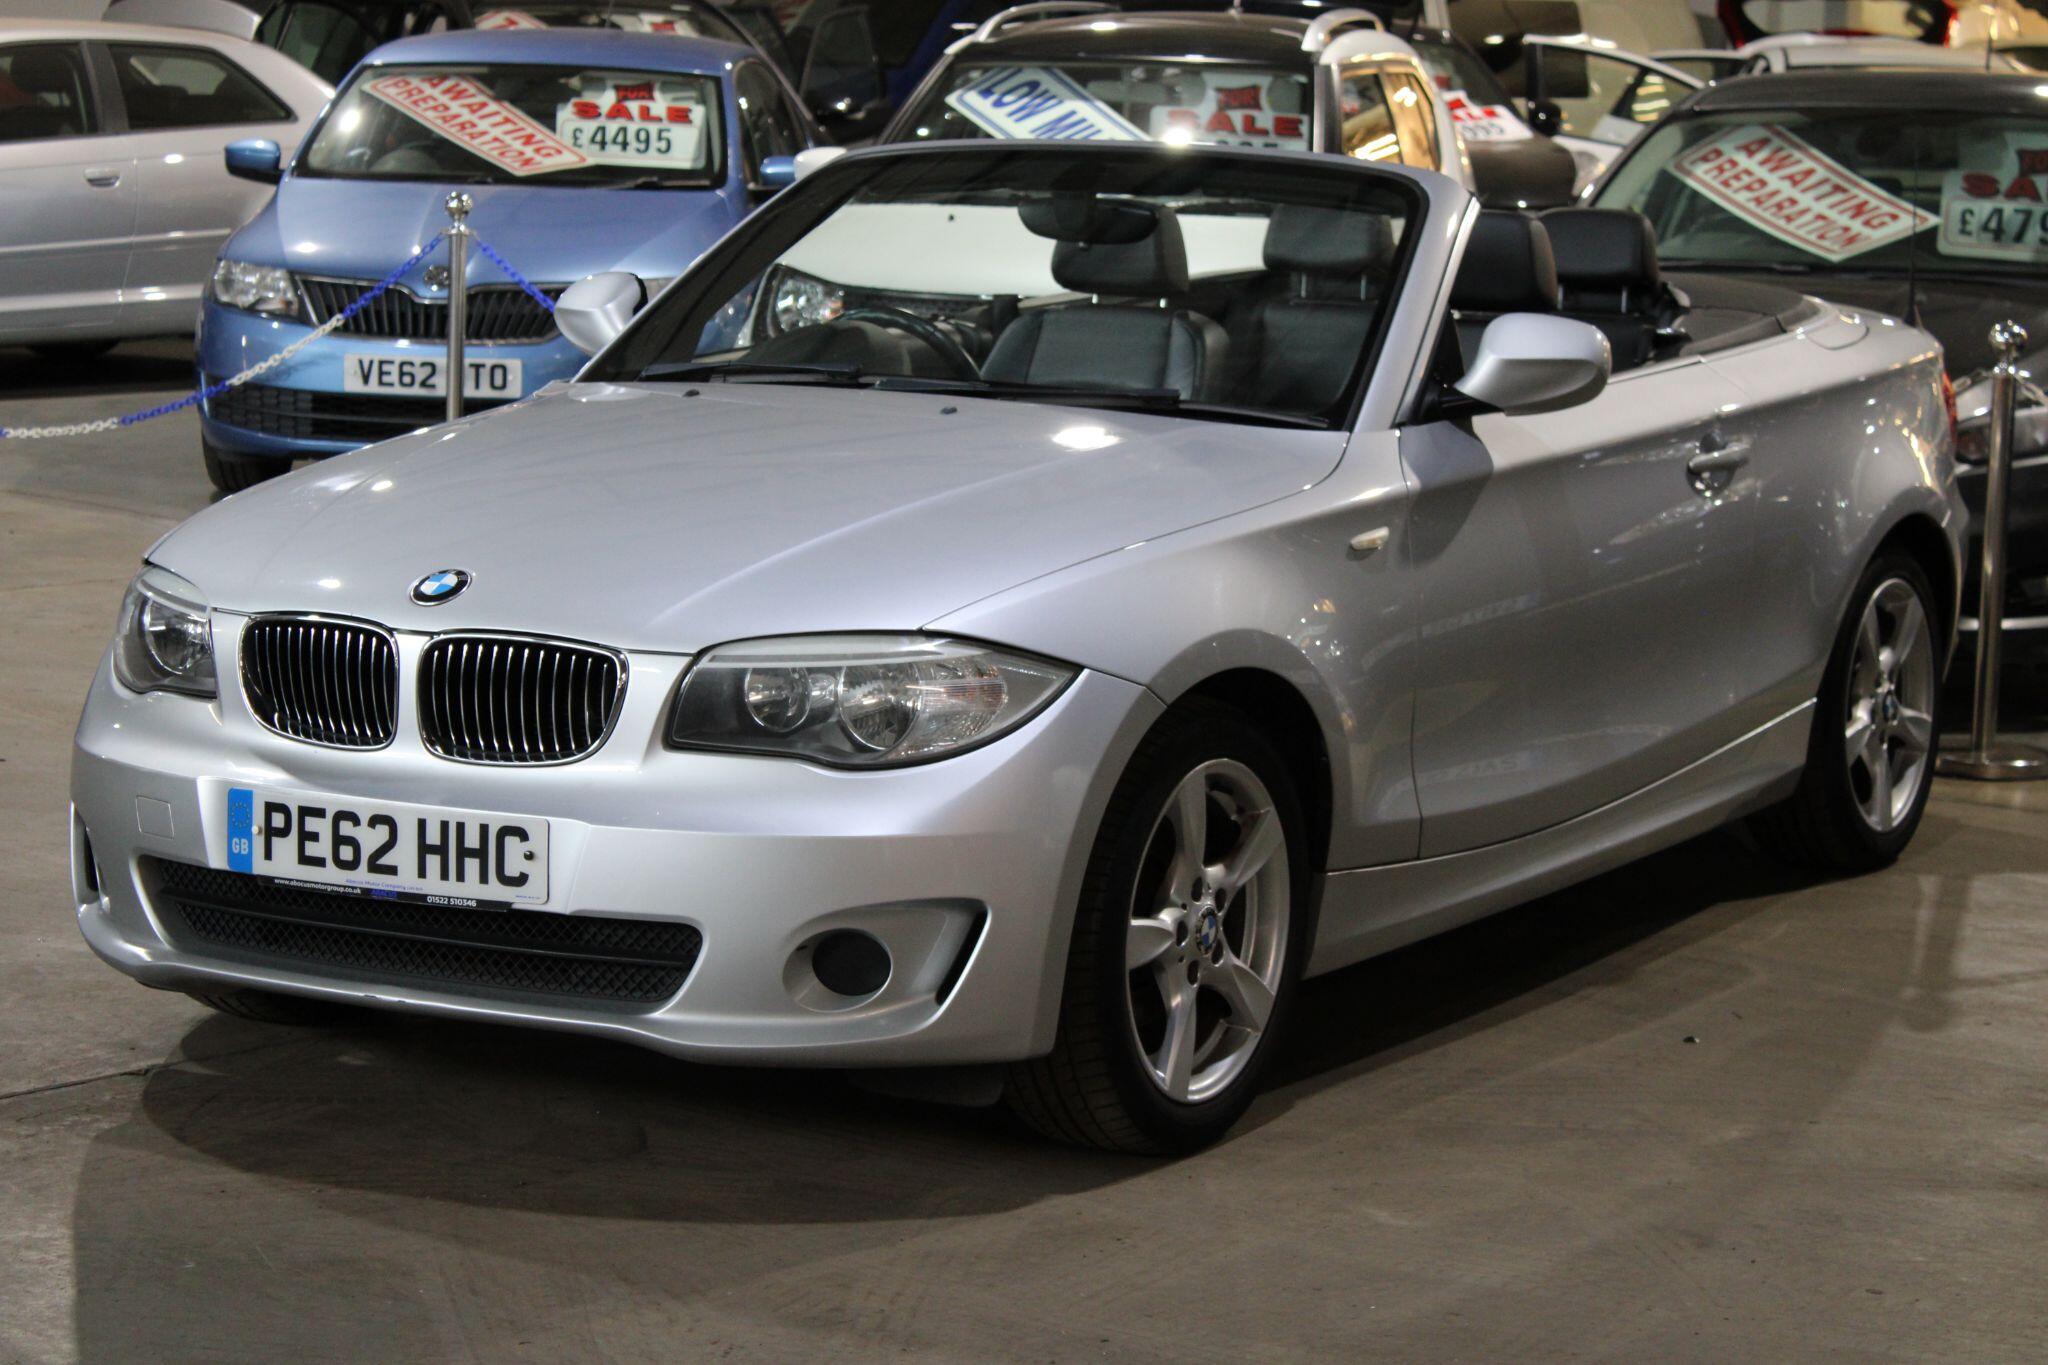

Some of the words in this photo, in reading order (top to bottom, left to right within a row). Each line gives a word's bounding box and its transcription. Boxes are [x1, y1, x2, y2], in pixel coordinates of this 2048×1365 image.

[572, 101, 693, 124] SALE
[977, 68, 1064, 122] LOW
[387, 78, 542, 167] PREPARATION
[421, 76, 563, 159] AWAITING
[572, 126, 672, 154] £4495
[1690, 148, 1870, 248] PREPARATION
[1735, 137, 1899, 231] AWAITING
[1962, 173, 2048, 203] SA
[358, 359, 437, 389] VE62
[465, 363, 508, 391] TO
[232, 837, 249, 854] GB
[264, 801, 398, 876] PE62
[417, 818, 531, 888] HHC
[427, 895, 448, 904] 01522
[450, 897, 477, 907] 510346
